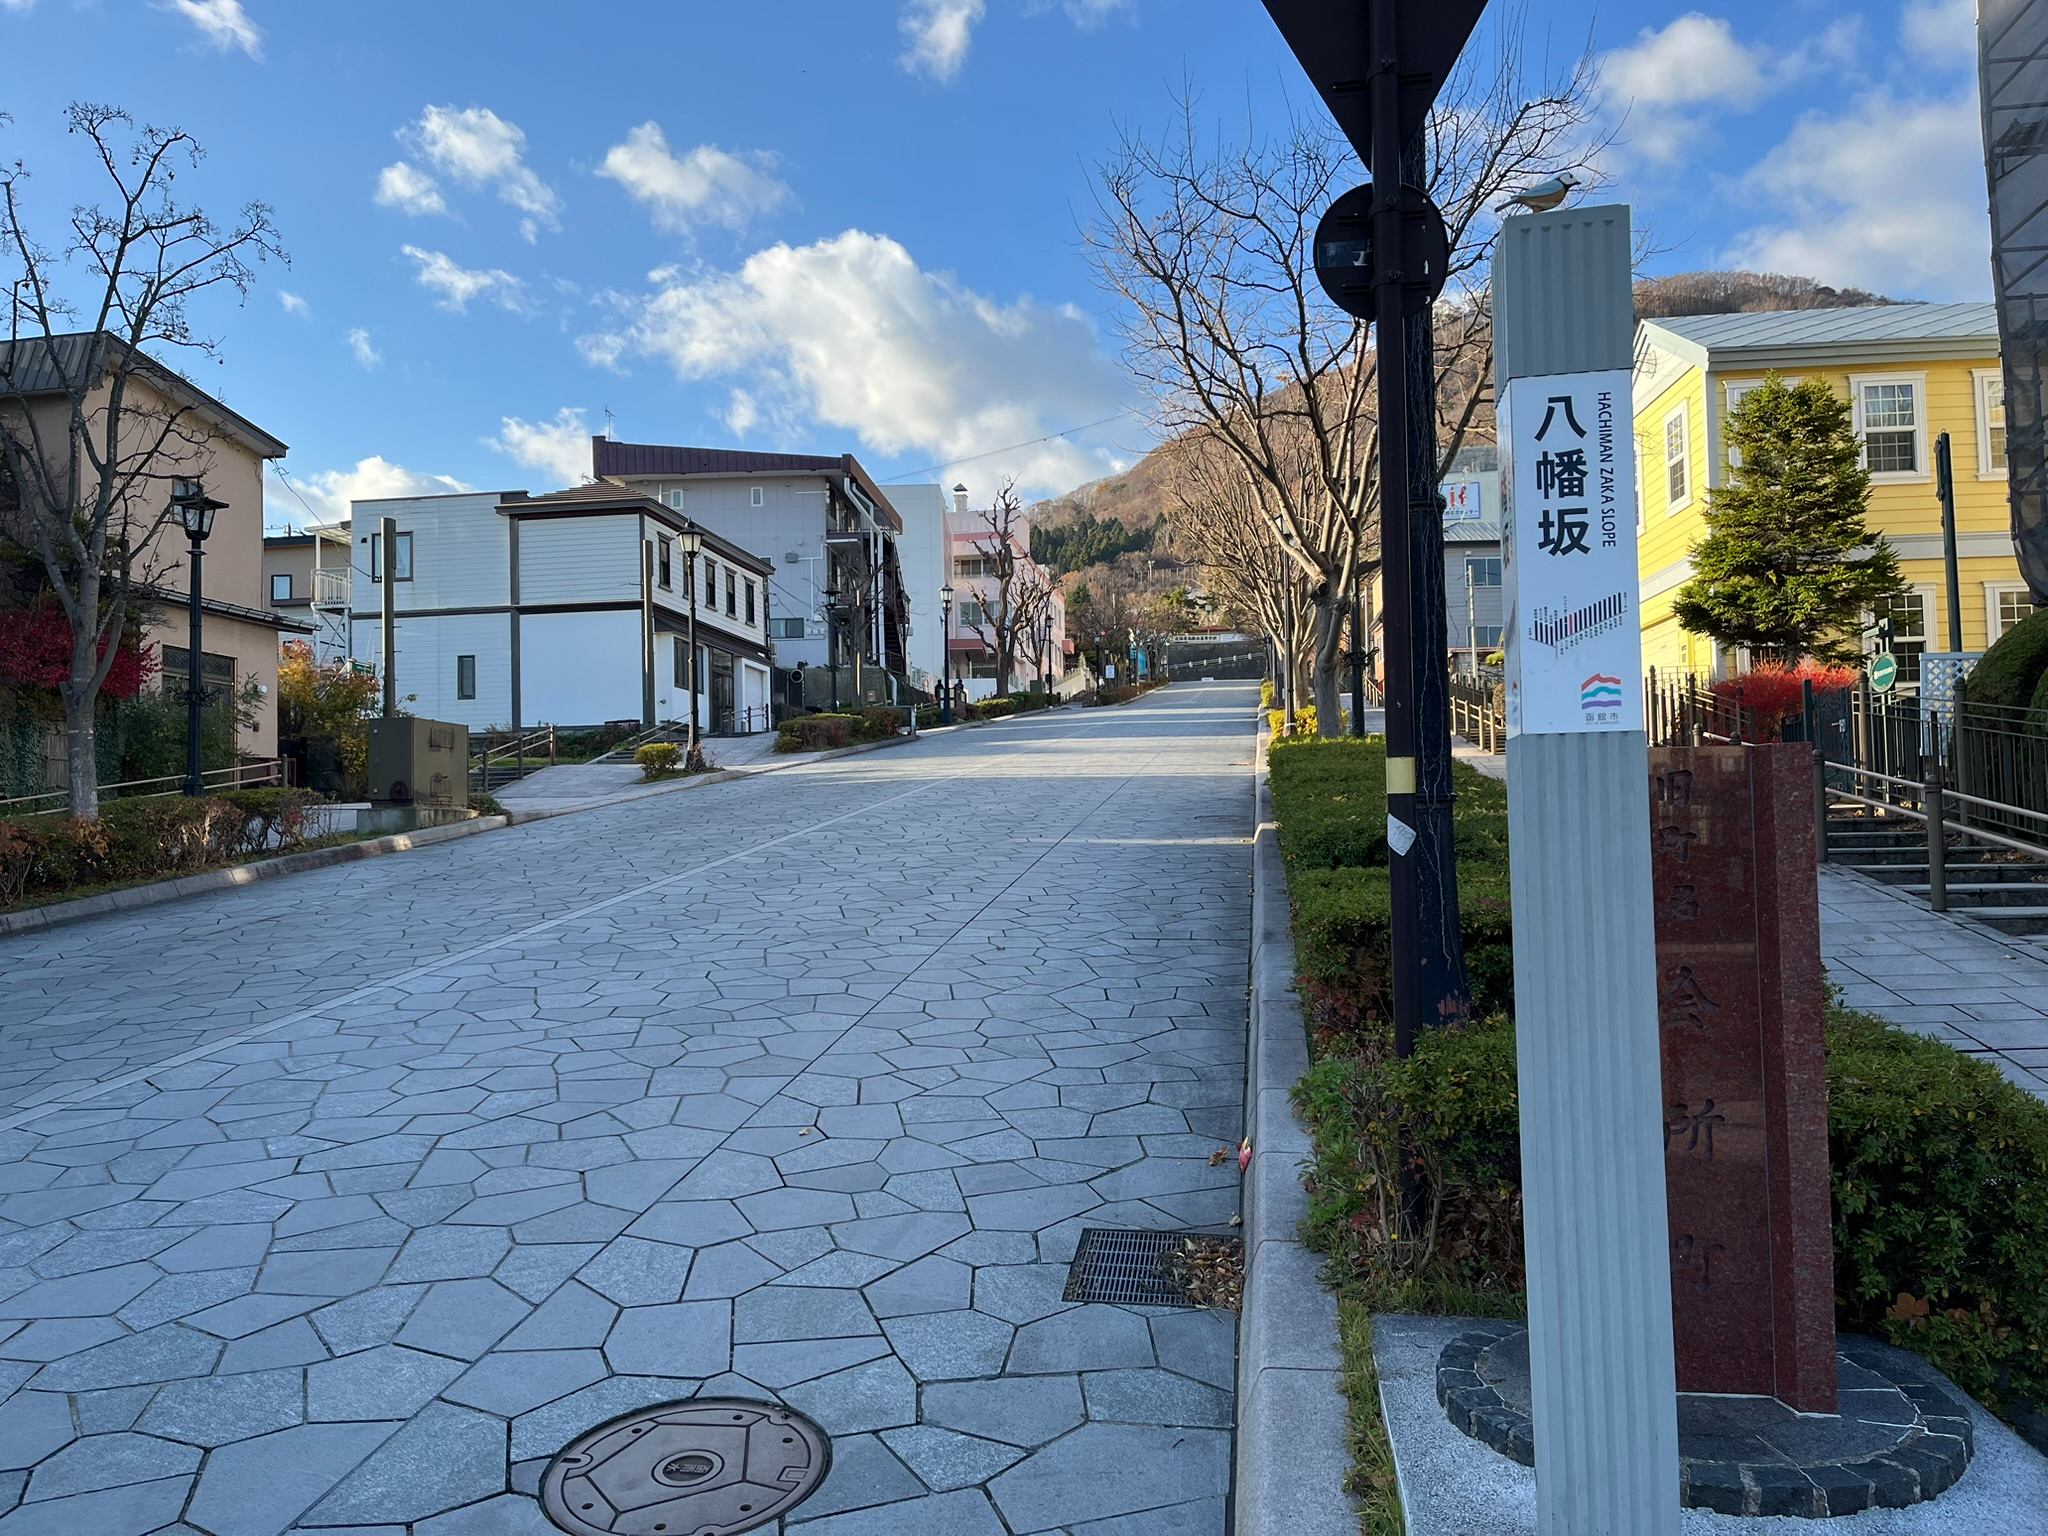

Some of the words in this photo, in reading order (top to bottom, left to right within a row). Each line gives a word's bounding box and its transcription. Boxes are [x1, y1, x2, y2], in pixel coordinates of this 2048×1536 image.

[1597, 391, 1613, 463] HACHIMAN
[1534, 395, 1592, 556] 八幡坂
[1600, 467, 1615, 505] ZAKA
[1601, 508, 1617, 548] SLOPE
